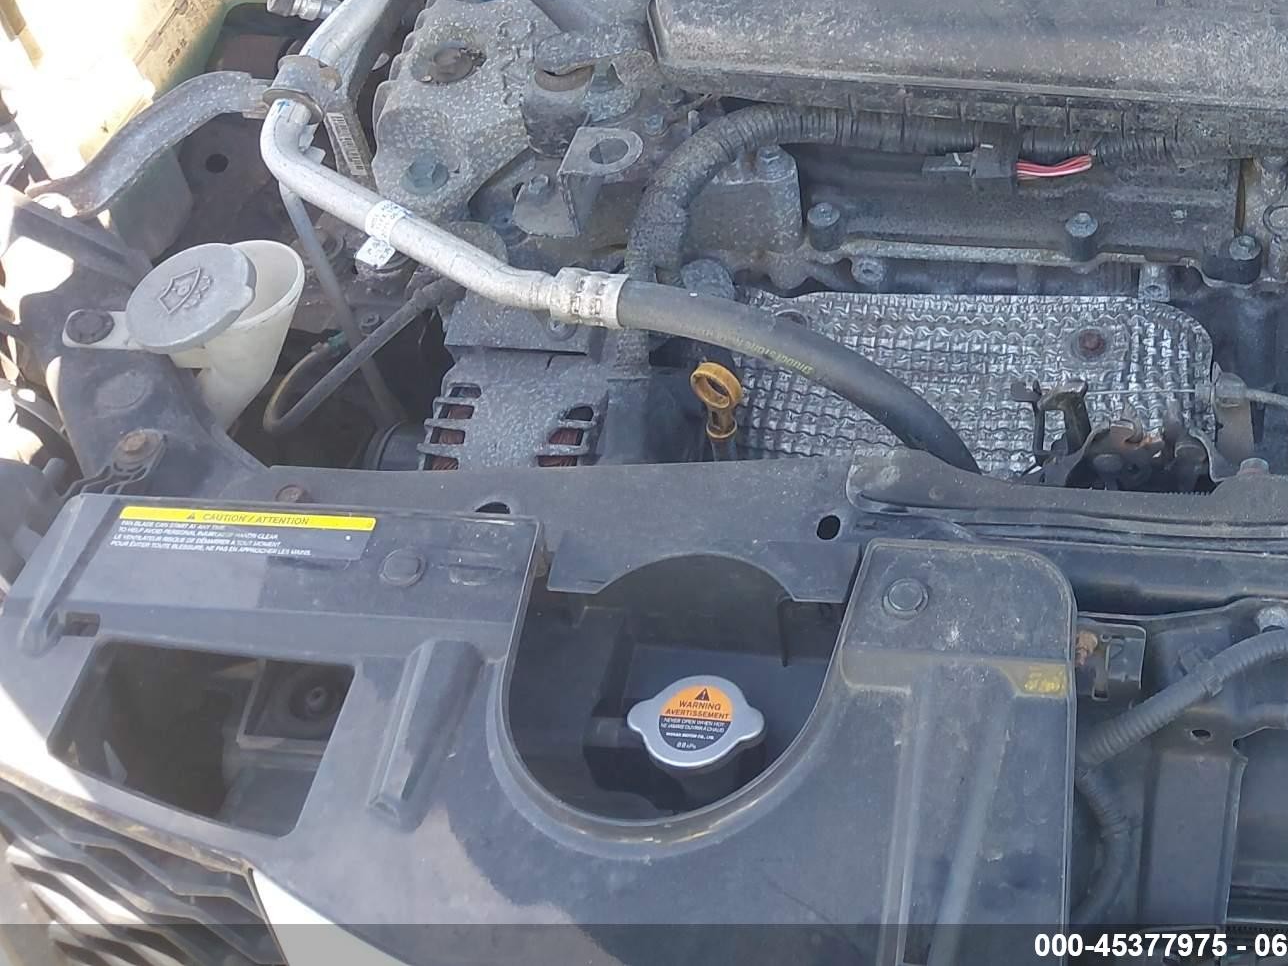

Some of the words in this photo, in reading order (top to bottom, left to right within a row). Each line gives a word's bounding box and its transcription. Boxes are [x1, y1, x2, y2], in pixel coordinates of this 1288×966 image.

[203, 513, 246, 523] CAUTION
[247, 515, 255, 523] /
[255, 515, 310, 526] ATTENTION
[679, 700, 721, 711] WARNING
[664, 708, 730, 720] AVERTISSEMENT
